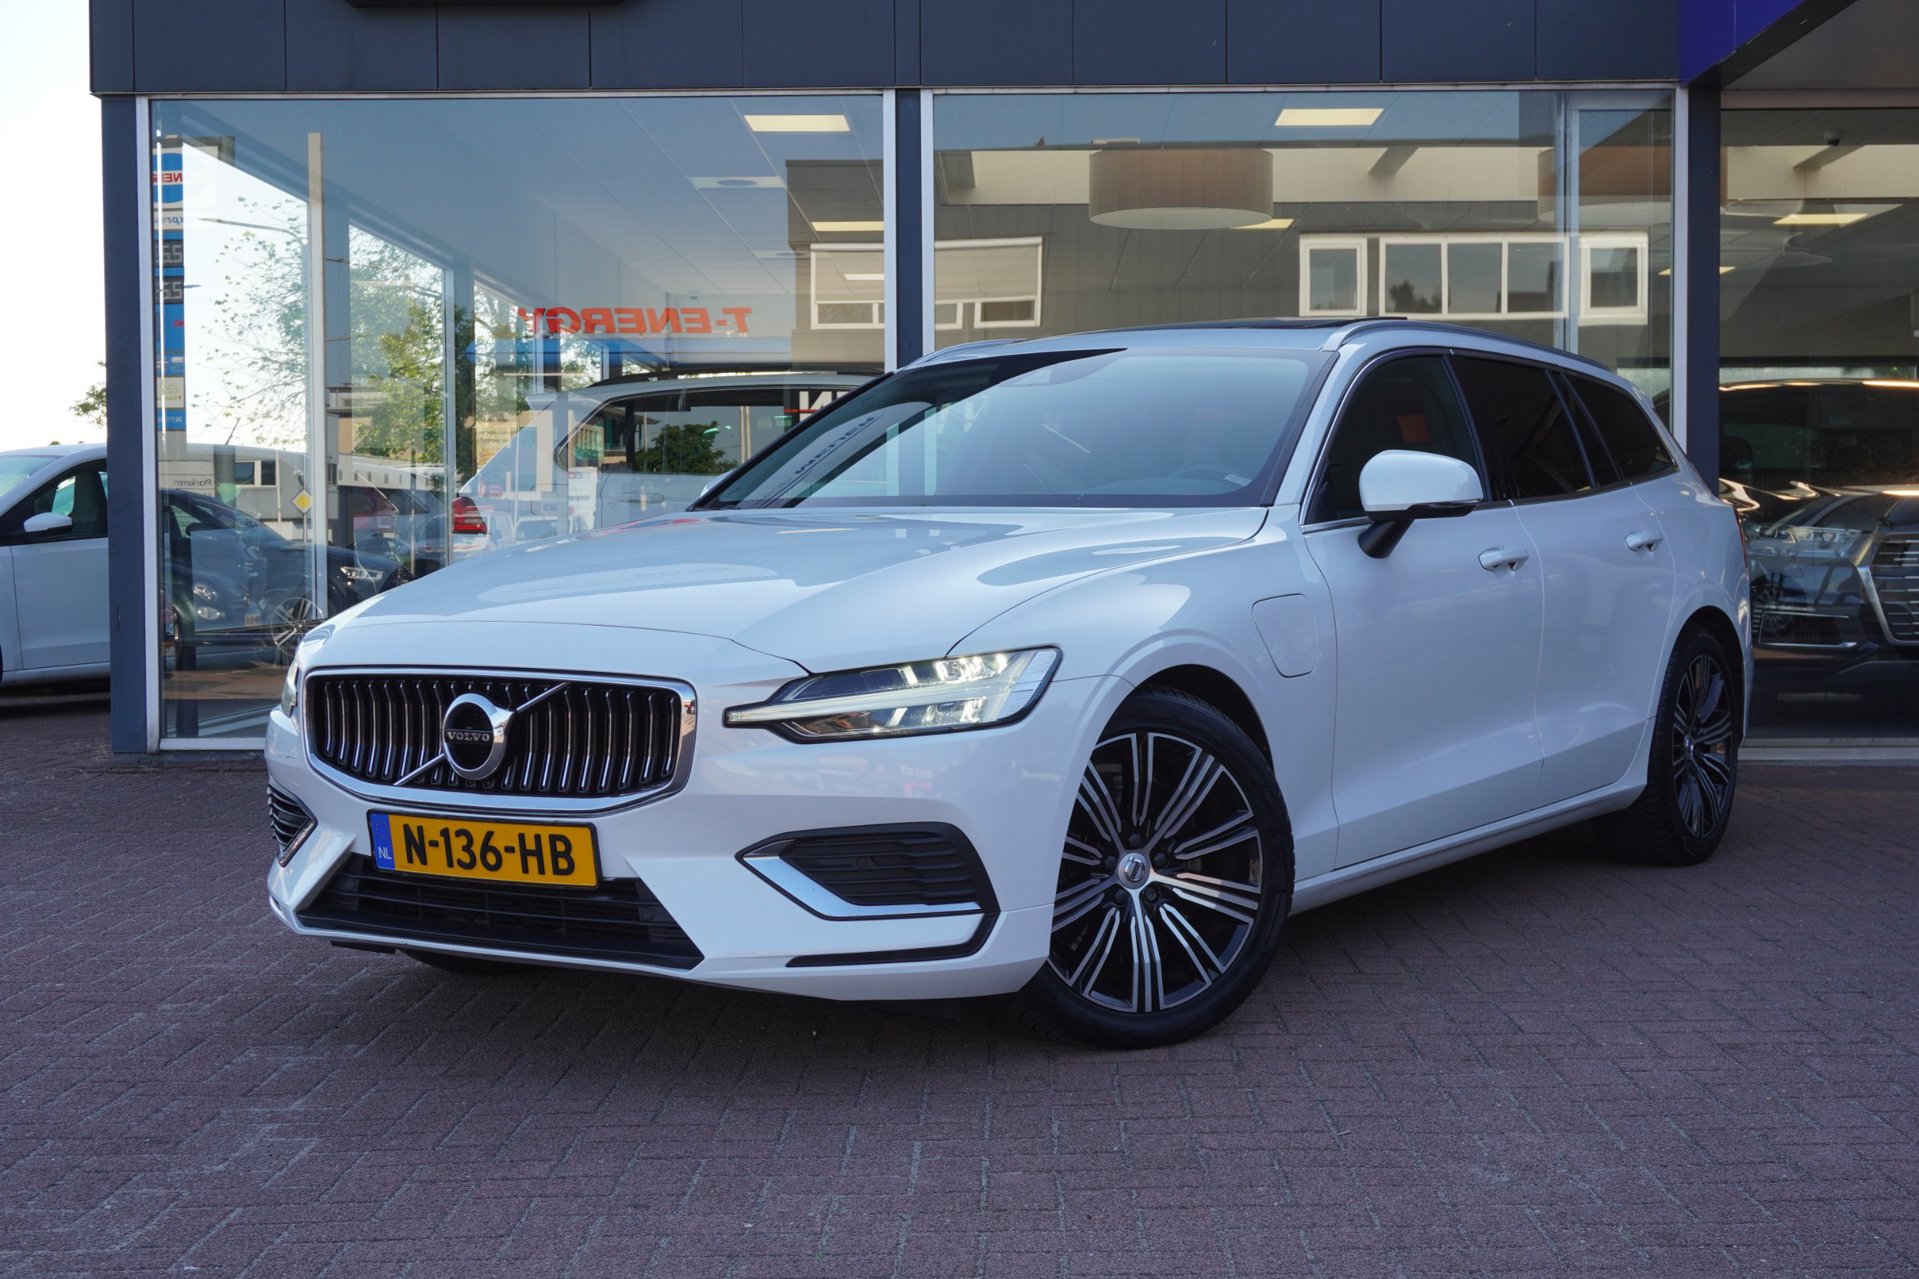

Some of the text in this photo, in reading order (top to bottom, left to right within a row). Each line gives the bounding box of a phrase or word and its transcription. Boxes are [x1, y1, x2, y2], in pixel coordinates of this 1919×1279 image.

[447, 731, 490, 742] VOLVO
[378, 846, 392, 860] NL
[402, 823, 576, 876] N-136-HB
